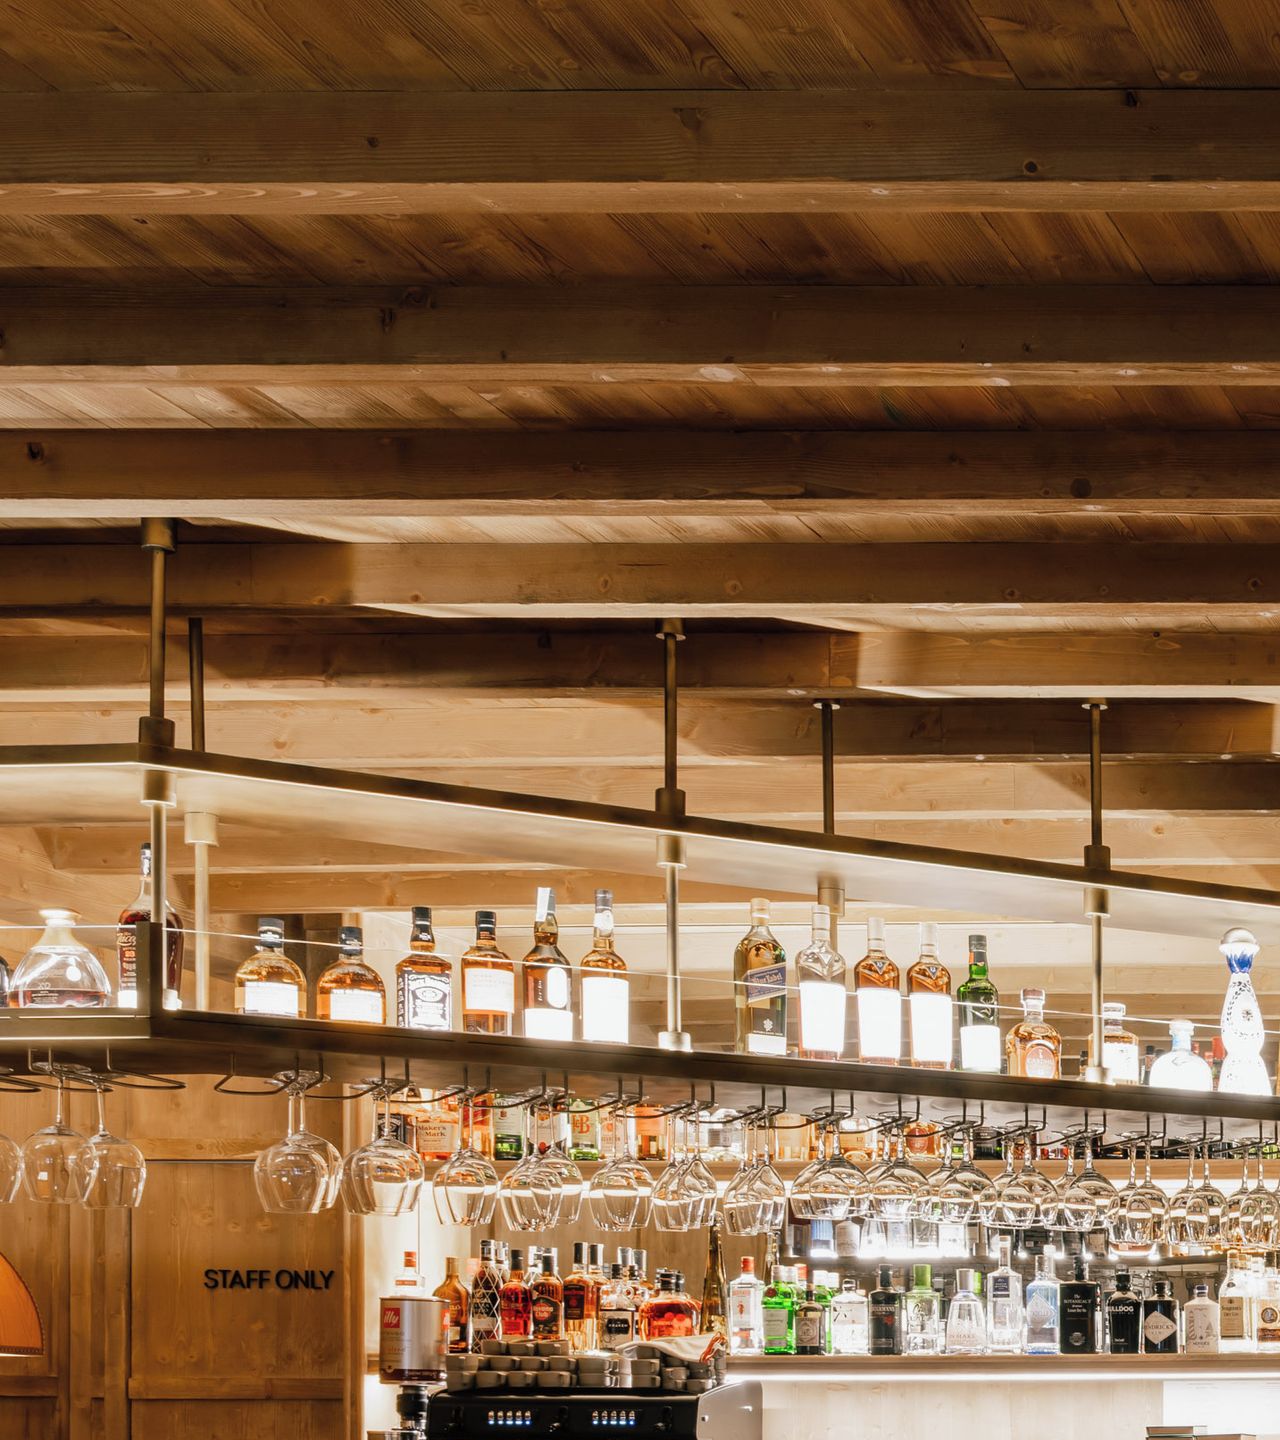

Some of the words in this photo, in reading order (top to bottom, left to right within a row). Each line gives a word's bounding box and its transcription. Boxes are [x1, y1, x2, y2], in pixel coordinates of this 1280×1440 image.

[204, 1269, 271, 1289] STAFF
[275, 1269, 335, 1290] ONLY
[384, 1310, 399, 1327] illy
